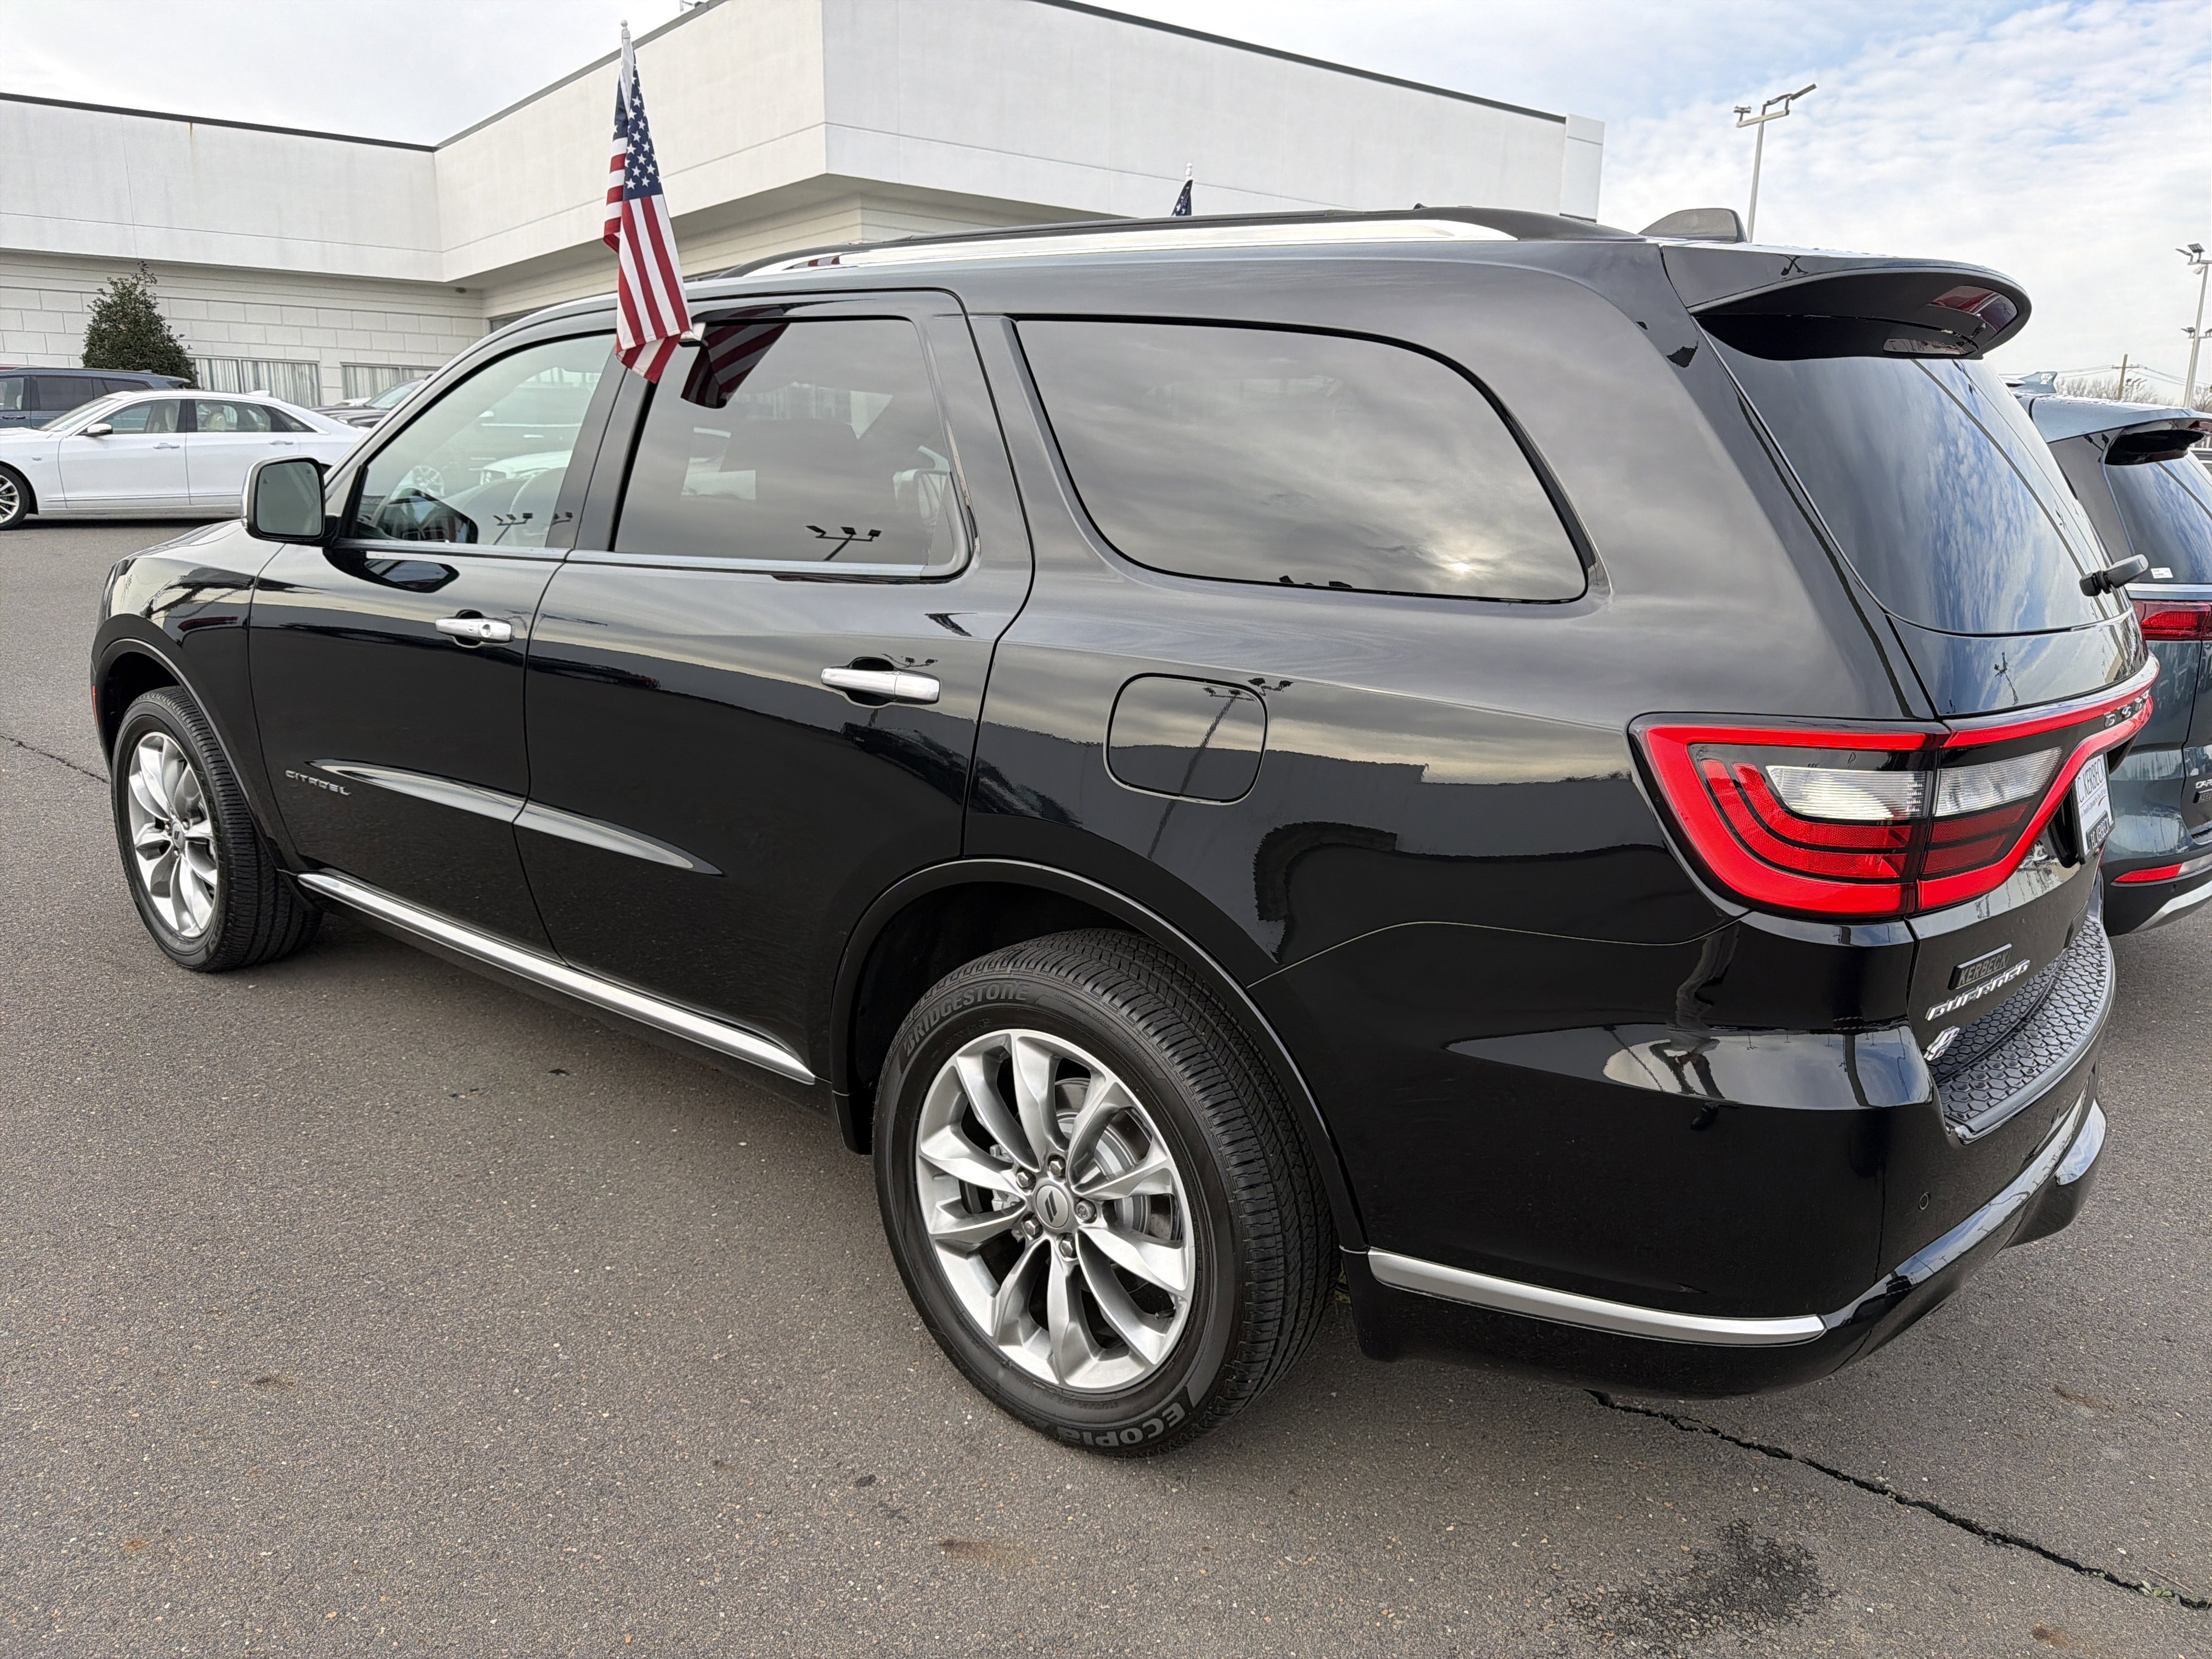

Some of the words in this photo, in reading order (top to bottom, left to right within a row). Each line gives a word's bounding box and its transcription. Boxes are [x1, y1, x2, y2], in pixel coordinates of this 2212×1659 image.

[285, 769, 352, 795] CITADEL
[2083, 756, 2106, 798] KERBECK
[1925, 958, 2030, 1021] DURANGO
[1957, 950, 2011, 986] KERBECK
[902, 981, 1032, 1058] BRIDGESTONE
[1057, 1402, 1186, 1447] ECOPIA
